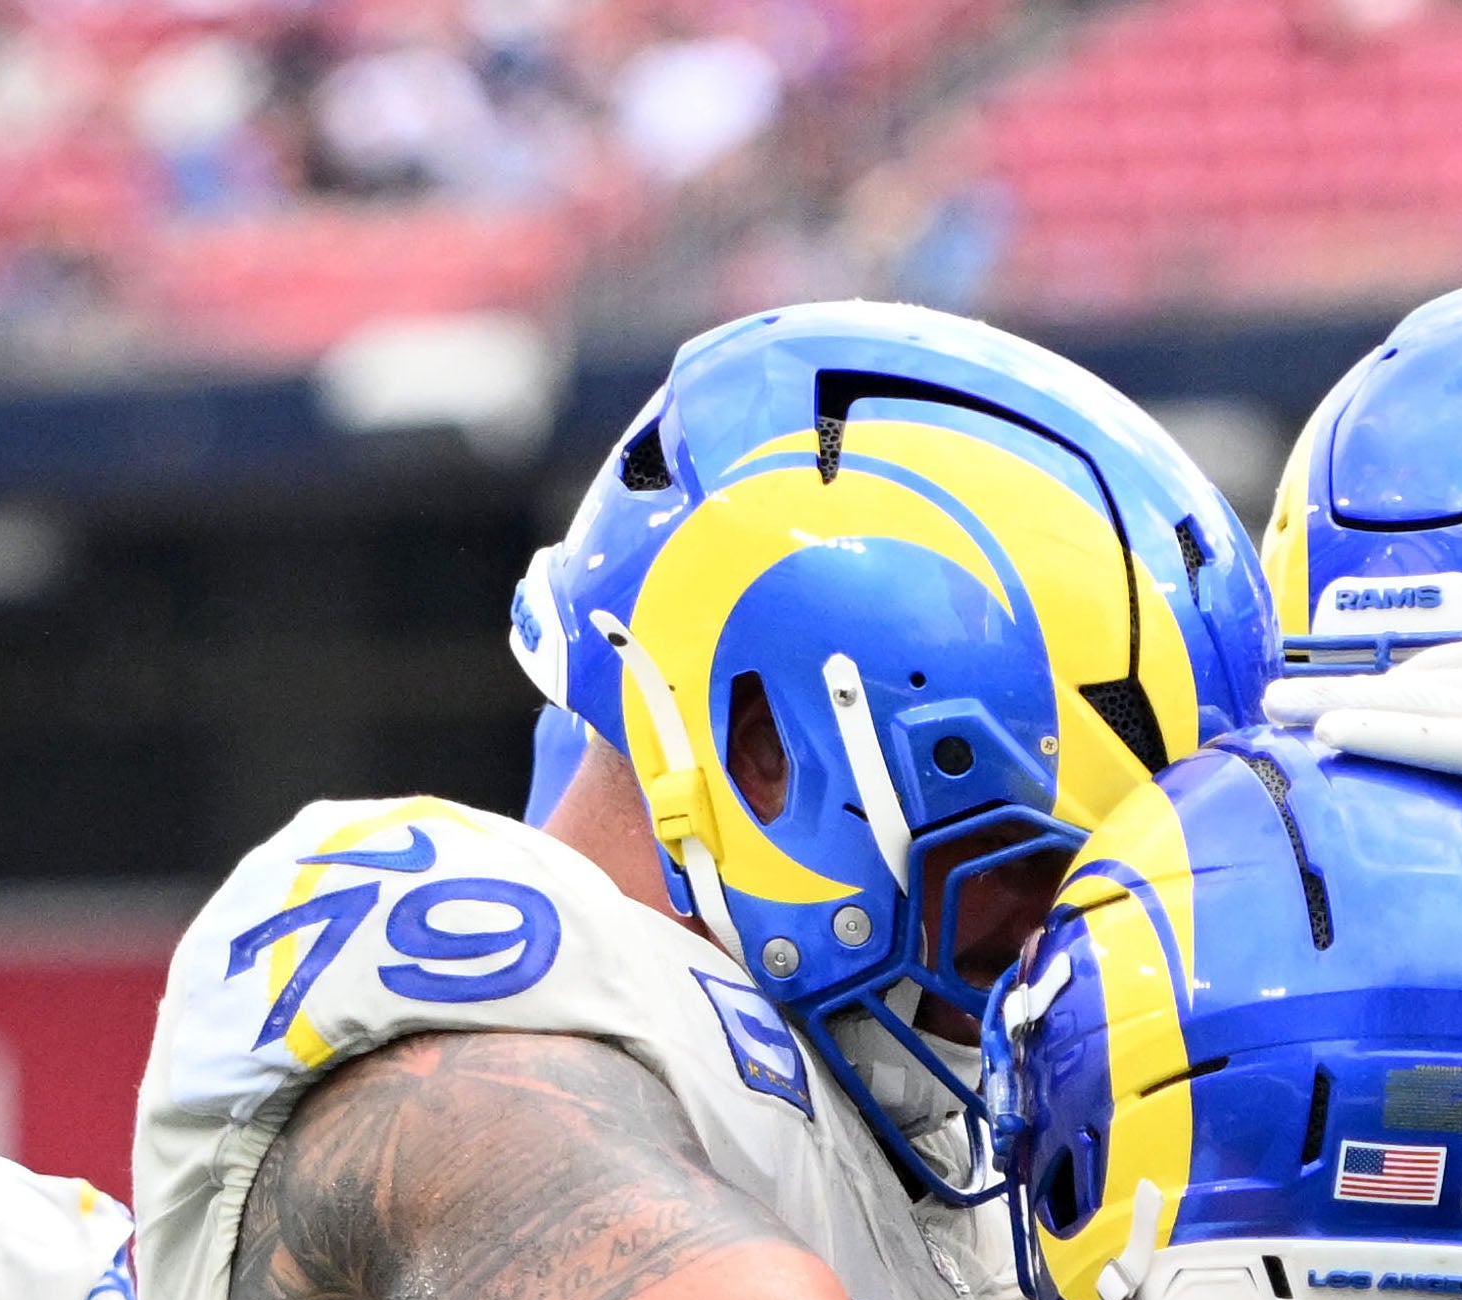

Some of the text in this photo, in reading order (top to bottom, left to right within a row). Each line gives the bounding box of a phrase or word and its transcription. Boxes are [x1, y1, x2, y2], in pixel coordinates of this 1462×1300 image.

[1335, 585, 1443, 611] RAMS
[224, 876, 563, 1052] 79
[1307, 1268, 1374, 1290] LOS
